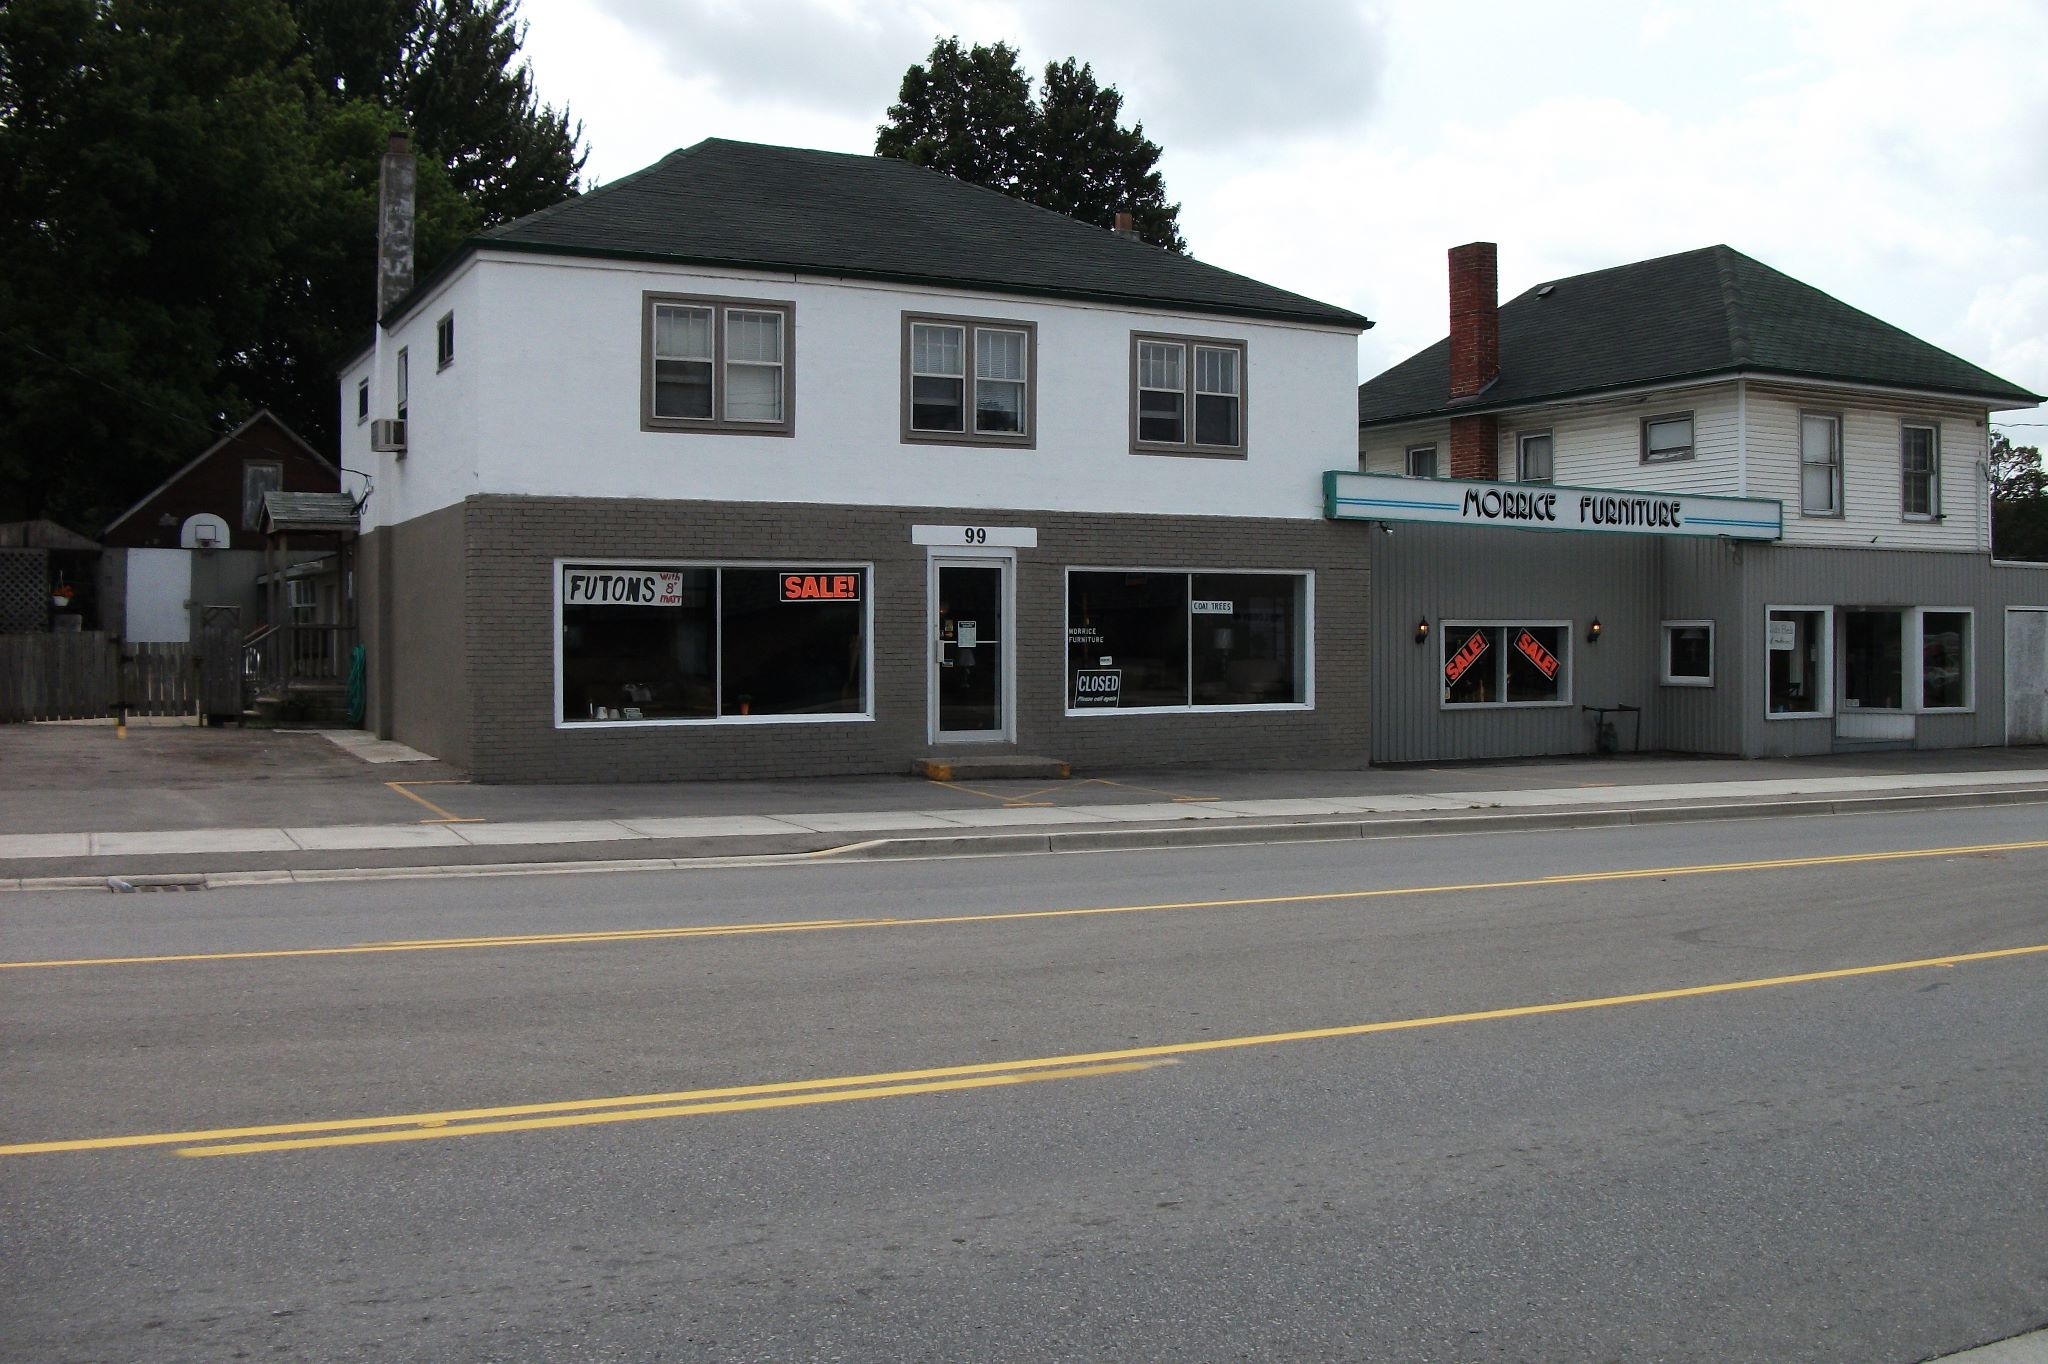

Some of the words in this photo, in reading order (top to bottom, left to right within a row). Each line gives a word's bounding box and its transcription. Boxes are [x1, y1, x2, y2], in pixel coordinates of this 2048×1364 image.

[1462, 487, 1557, 521] MORRICE
[1579, 496, 1681, 528] FURNITURE
[965, 527, 986, 544] 99
[570, 575, 656, 602] FUTONS
[785, 576, 855, 598] SALE!
[1211, 602, 1231, 611] TREES
[1068, 627, 1097, 635] MORRICE
[1445, 633, 1486, 680] SALE!
[1518, 633, 1558, 676] SALE!
[1078, 675, 1119, 692] CLOSED
